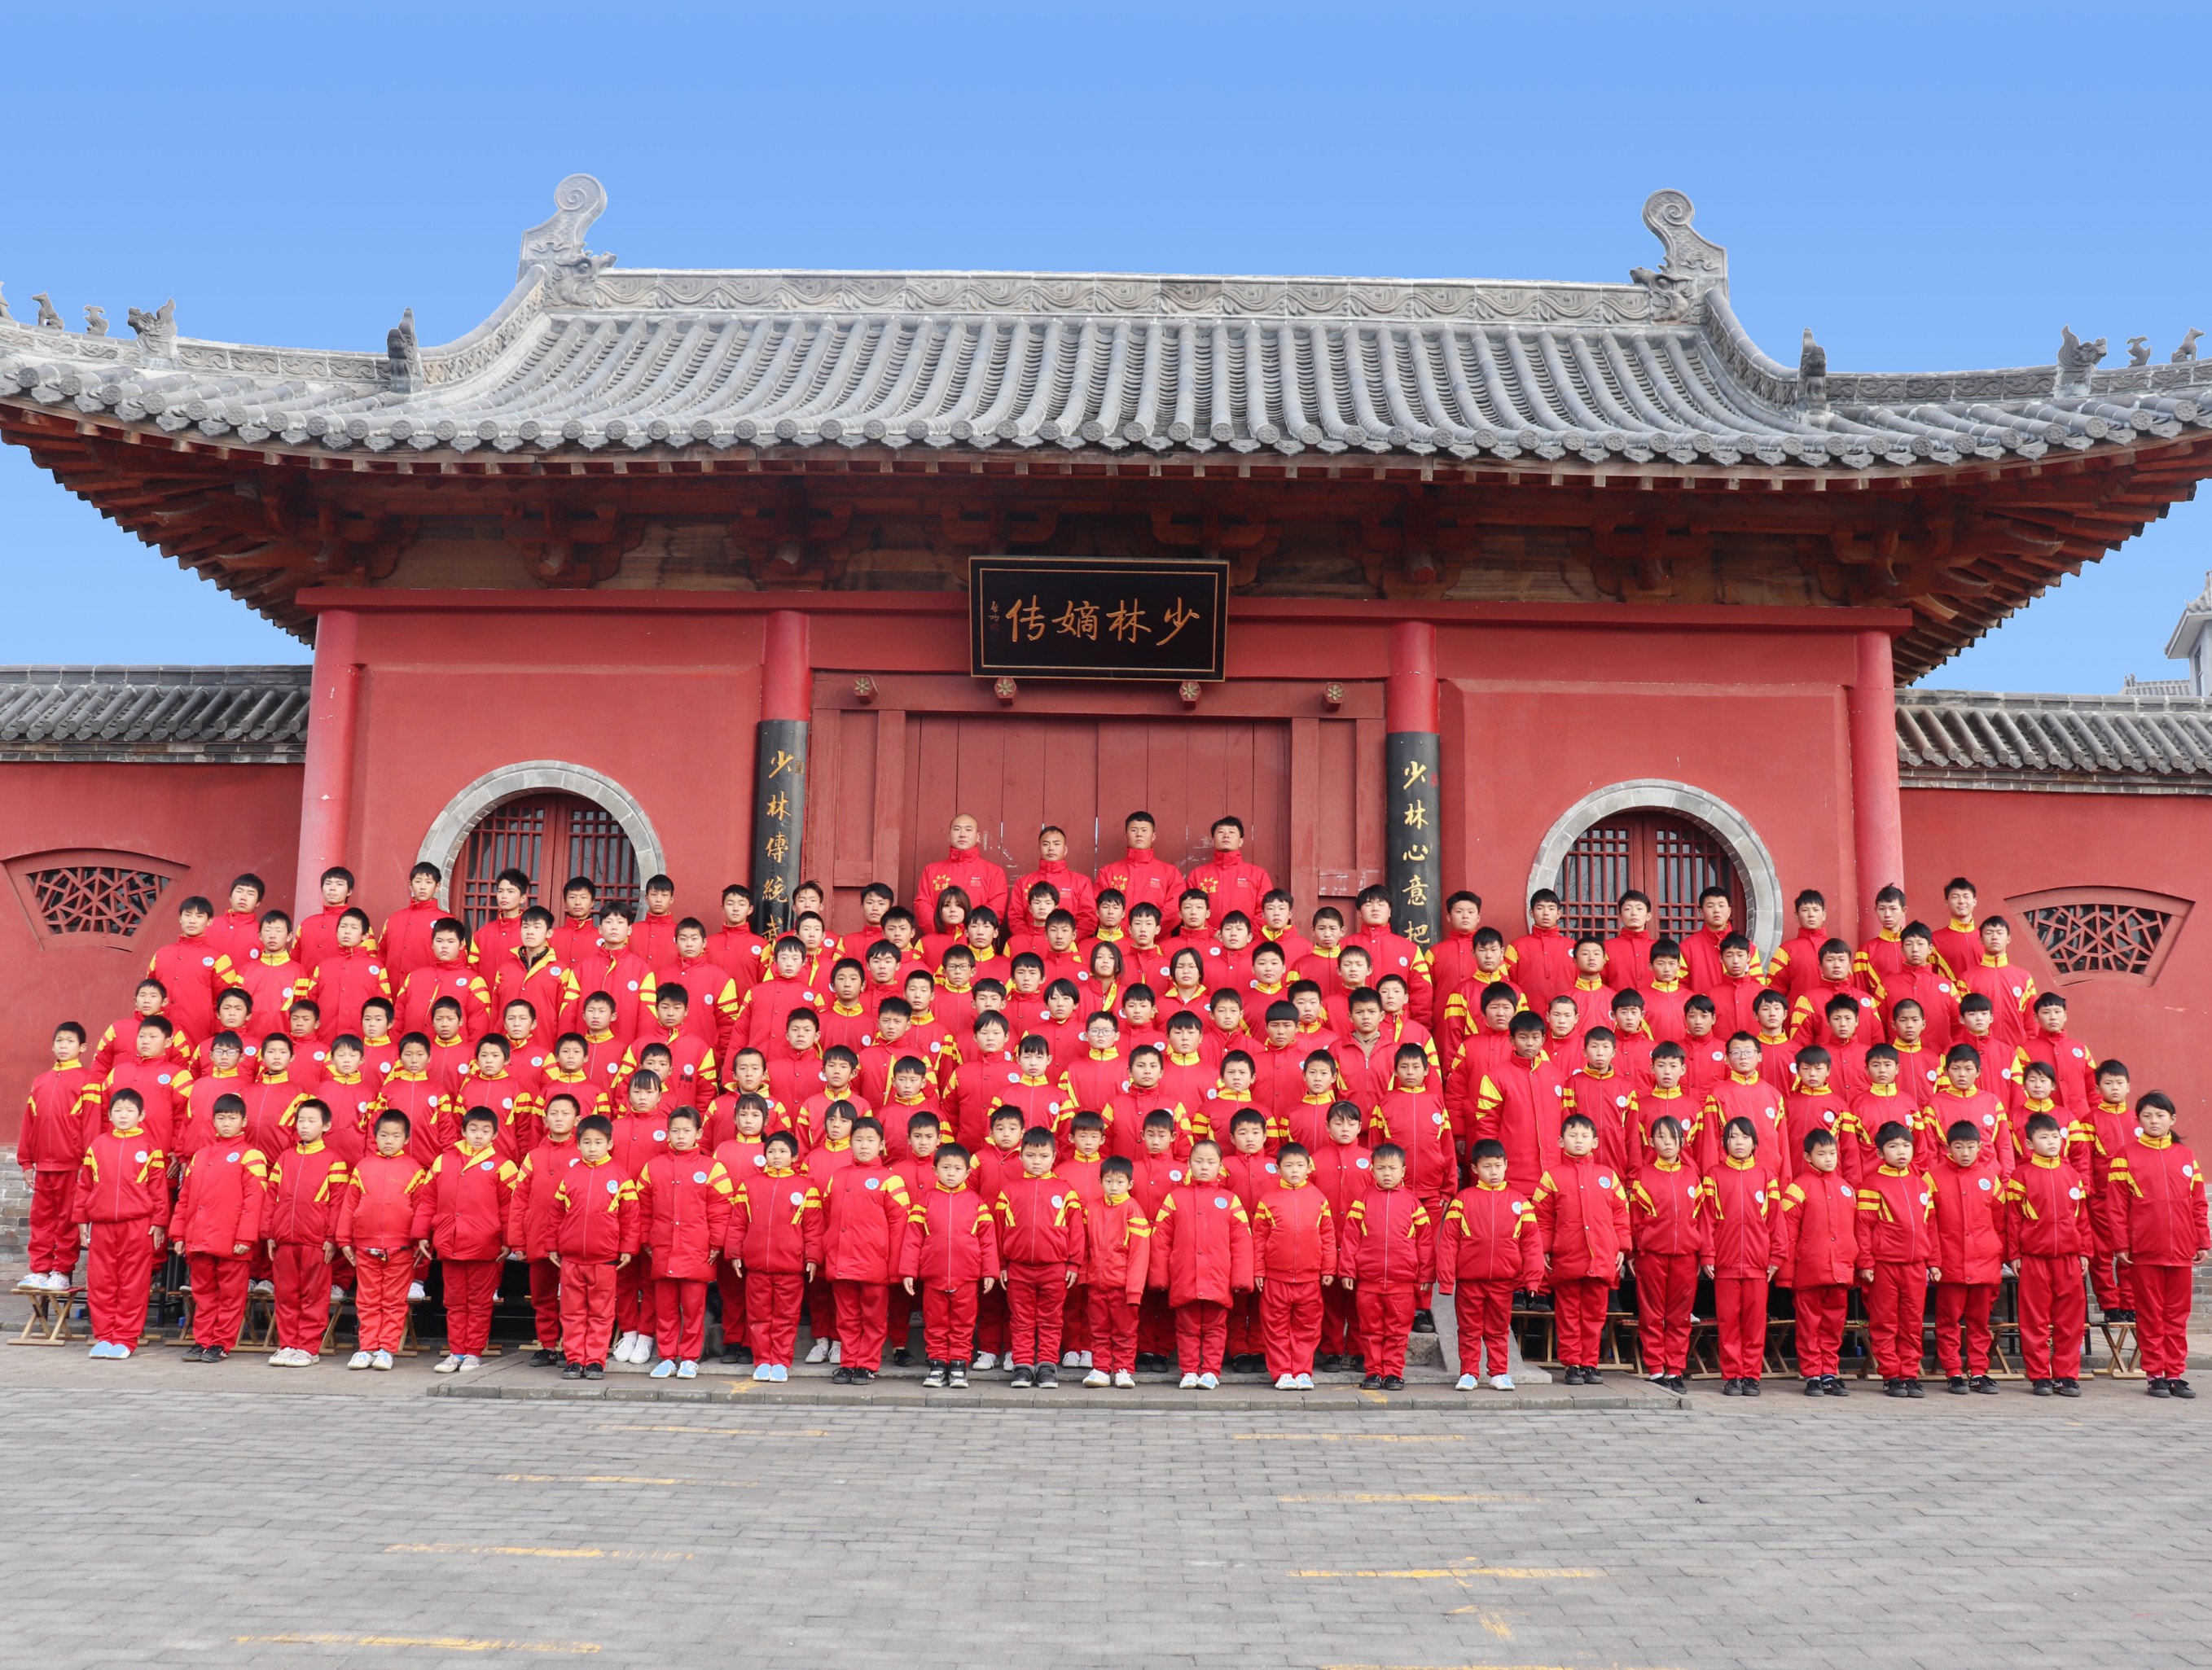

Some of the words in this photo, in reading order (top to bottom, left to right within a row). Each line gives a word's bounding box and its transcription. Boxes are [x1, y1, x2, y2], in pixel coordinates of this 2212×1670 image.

[1005, 595, 1200, 646] 少林嫡传
[1402, 760, 1430, 944] 少林心意把
